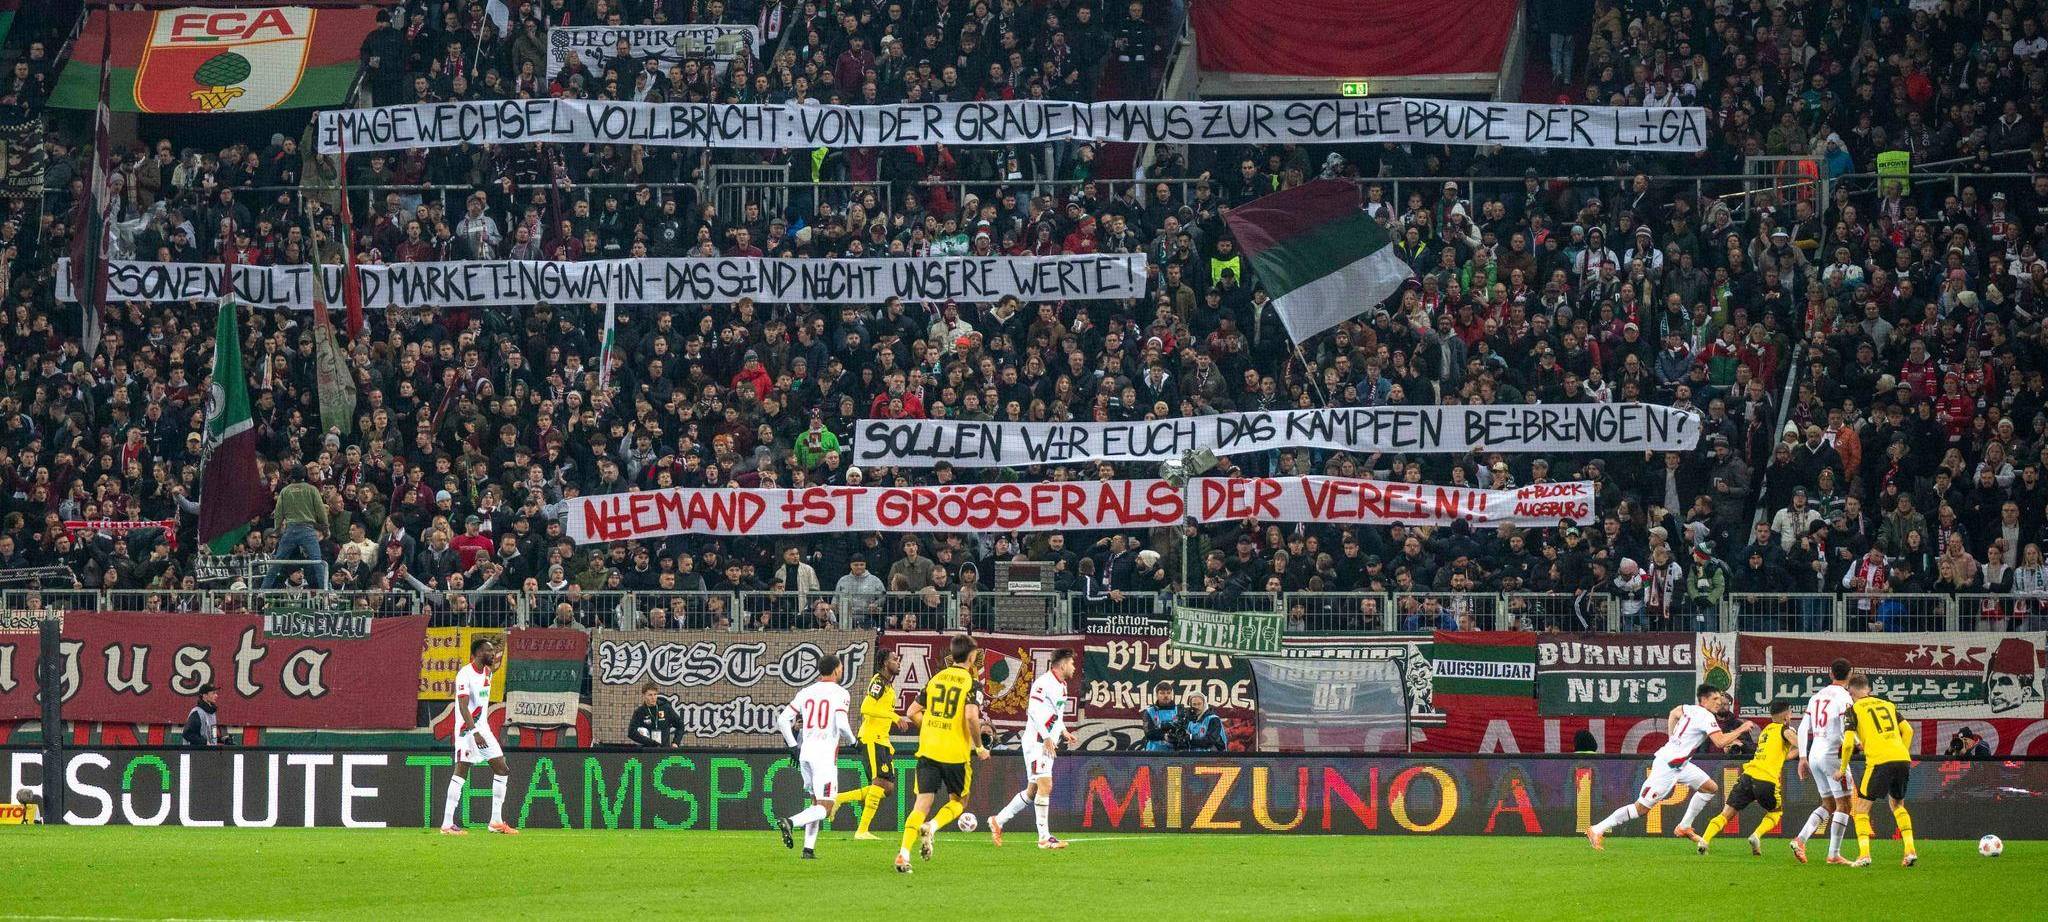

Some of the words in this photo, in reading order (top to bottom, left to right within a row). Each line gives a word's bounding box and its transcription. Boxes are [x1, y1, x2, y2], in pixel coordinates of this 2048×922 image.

[171, 9, 294, 40] FCA
[323, 98, 573, 147] IMAGEWECHSEL
[878, 105, 943, 143] DER
[955, 102, 1094, 142] GRAUEN
[1105, 103, 1194, 141] MAUS
[1201, 103, 1277, 140] ZUR
[1525, 107, 1594, 146] DER
[1614, 109, 1702, 146] LIGA
[325, 264, 379, 301] UD
[717, 260, 795, 296] SIND
[802, 264, 881, 300] NICHT
[892, 260, 998, 299] UNSERE
[1009, 256, 1135, 294] WERTE!
[861, 421, 1001, 461] SOLLEN
[1021, 425, 1090, 462] WIR
[1103, 421, 1196, 457] EUCH
[1217, 415, 1276, 449] DAS
[1286, 407, 1443, 447] KÄMPFEN
[1465, 404, 1690, 445] BEIBRINGEN?
[583, 491, 766, 541] NIEMAND
[781, 488, 868, 529] IST
[875, 485, 1087, 529] GRÖSSER
[1096, 480, 1183, 524] ALS
[1202, 479, 1282, 521] DER
[1302, 475, 1487, 521] VEREIN!!
[1513, 499, 1588, 518] AUGSBURG
[271, 610, 367, 638] LUSTENAU
[1179, 619, 1235, 649] TETE!
[1538, 642, 1692, 666] BURNING
[1436, 660, 1532, 679] AUGSBULGAR
[930, 683, 962, 720] 28
[1567, 677, 1668, 703] NUTS
[515, 702, 566, 716] SIMON!
[804, 699, 830, 730] 20
[1814, 699, 1831, 728] 13
[1867, 706, 1895, 735] 13
[1083, 764, 1458, 833] MIZUNO
